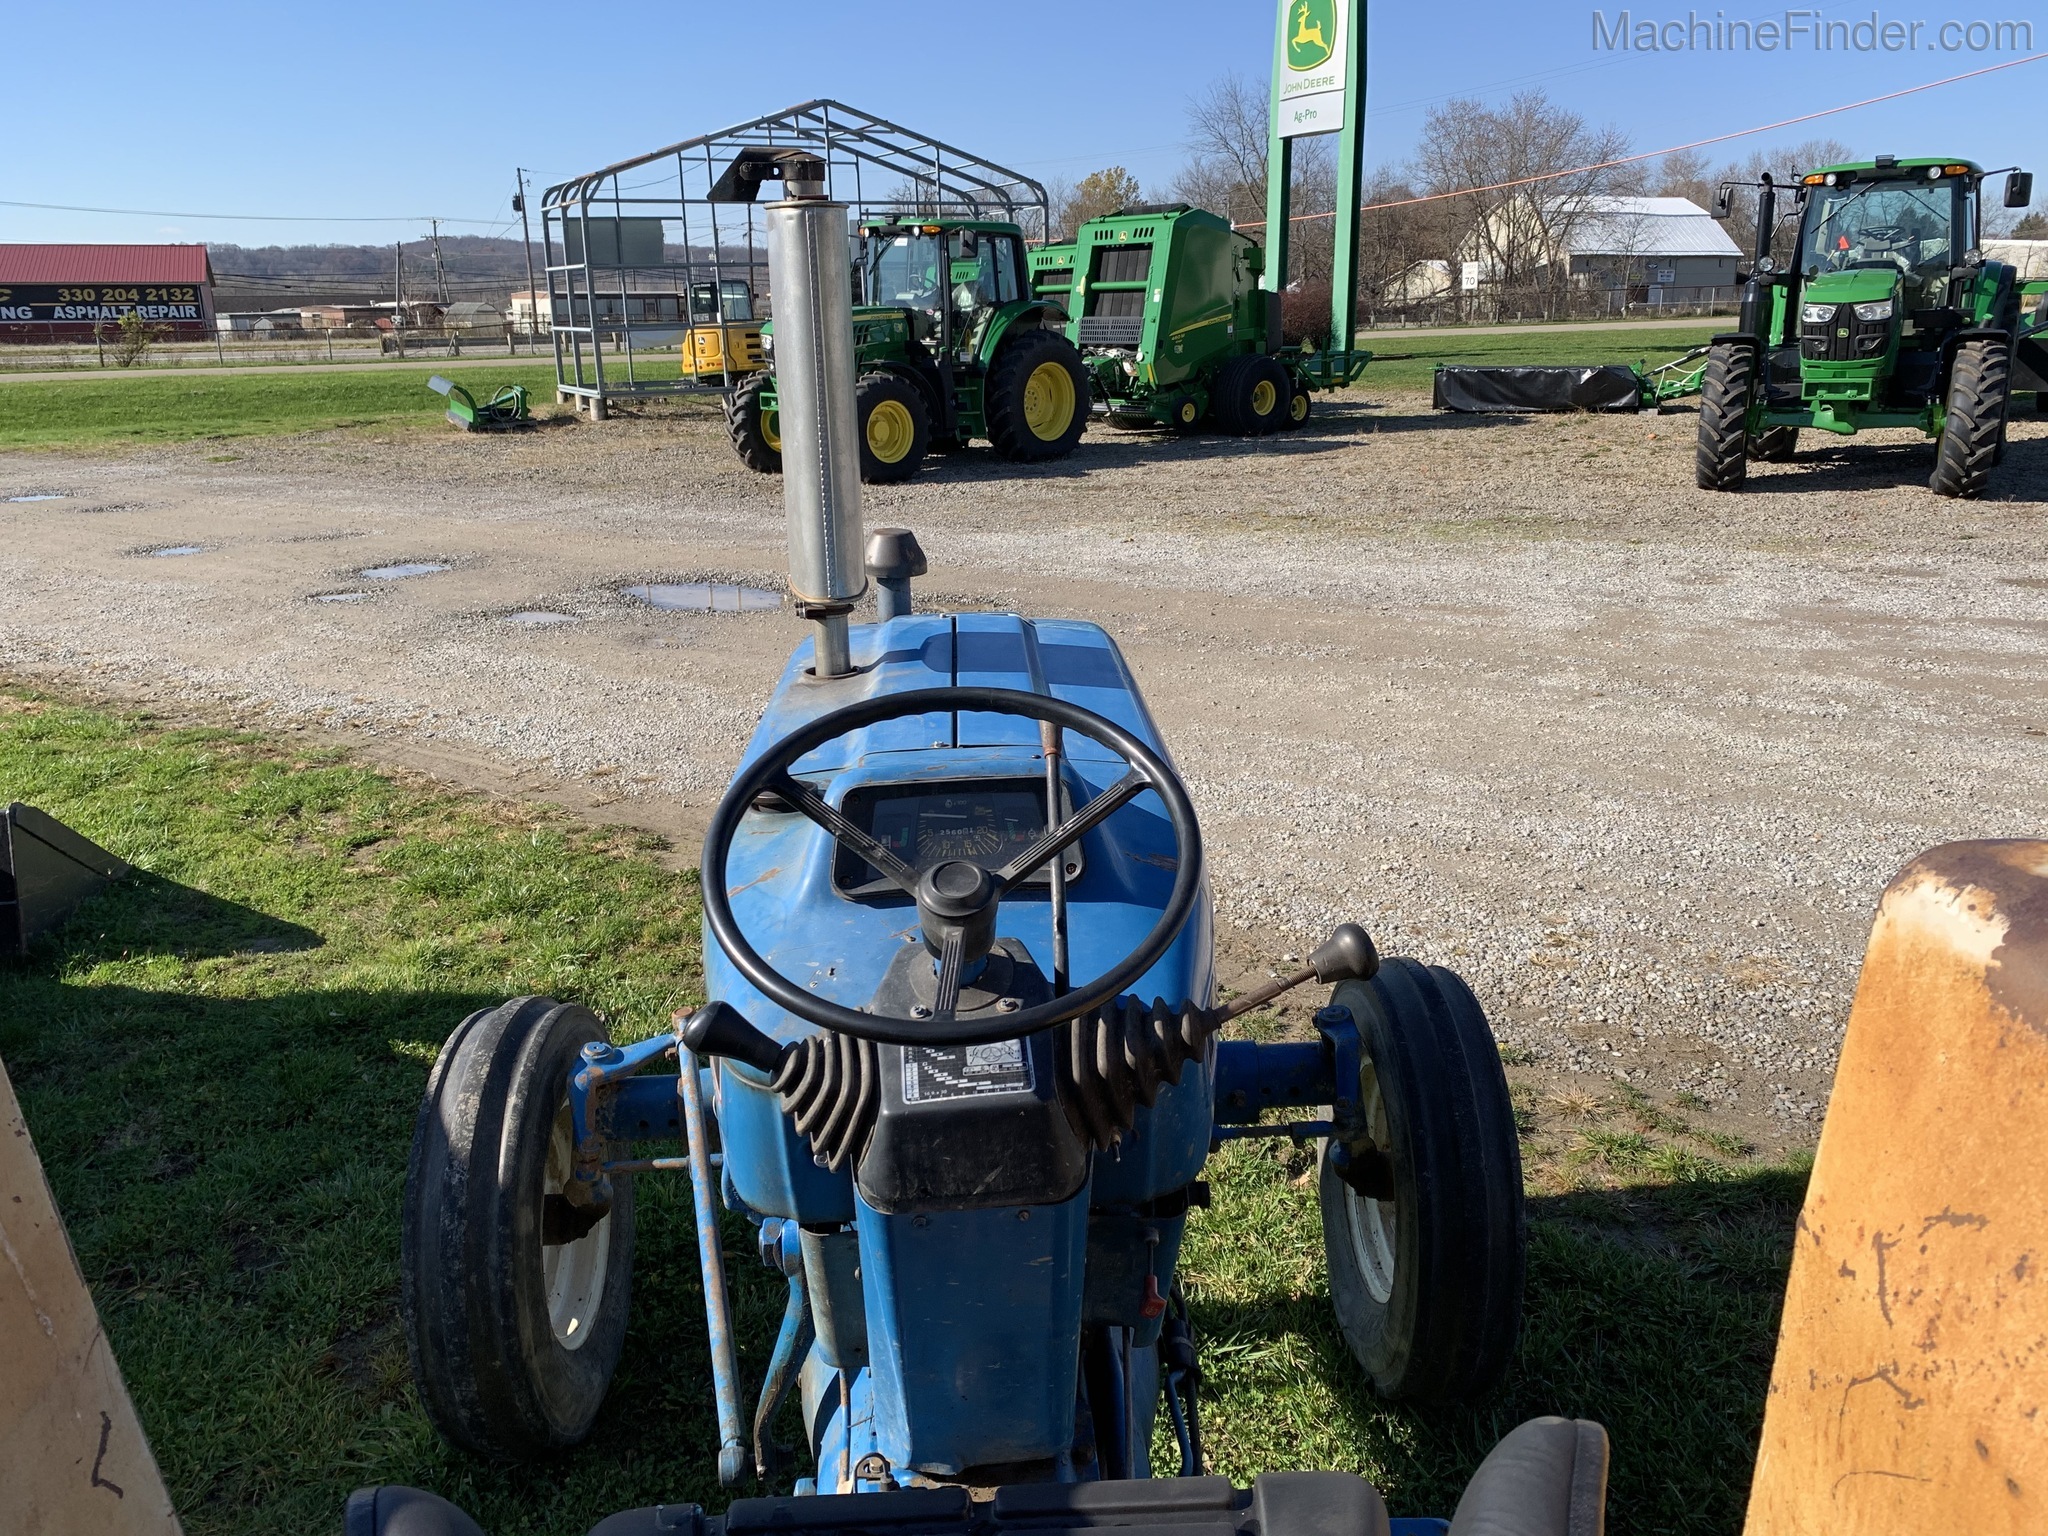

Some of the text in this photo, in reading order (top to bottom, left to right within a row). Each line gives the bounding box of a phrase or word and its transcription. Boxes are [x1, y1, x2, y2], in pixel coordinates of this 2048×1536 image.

[1283, 75, 1335, 95] JOHN DEERE
[1293, 108, 1318, 123] Ag-Pro
[1465, 276, 1475, 286] 70
[57, 288, 96, 302] 330
[101, 288, 140, 302] 204
[145, 287, 195, 301] 2132
[53, 305, 132, 319] ASPHALT
[135, 305, 198, 319] REPAIR
[976, 826, 988, 835] 20
[964, 839, 972, 848] 15
